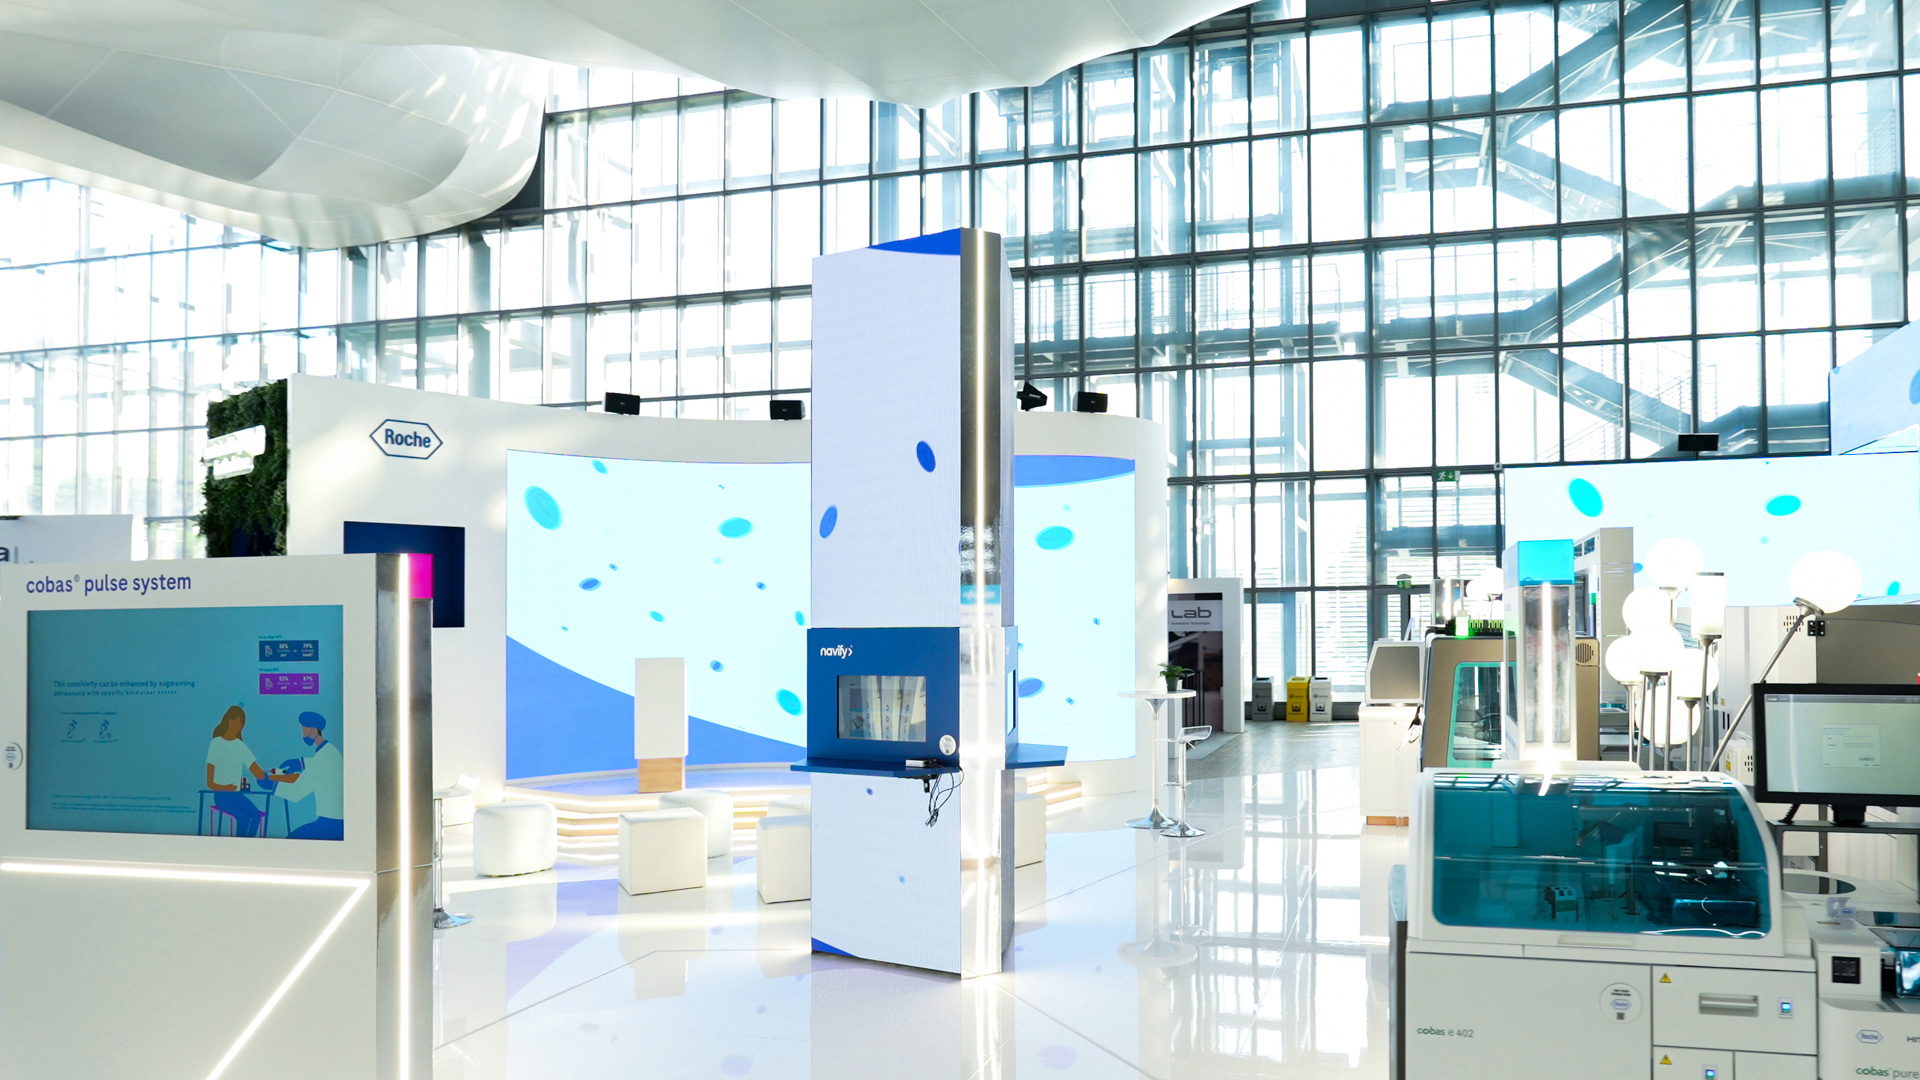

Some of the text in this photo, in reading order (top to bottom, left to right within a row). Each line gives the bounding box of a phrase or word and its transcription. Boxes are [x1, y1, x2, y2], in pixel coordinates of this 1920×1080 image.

[384, 428, 431, 448] Roche
[84, 574, 128, 597] pulse
[132, 574, 192, 596] system
[1171, 606, 1212, 619] Lab
[820, 644, 848, 660] navify
[110, 680, 119, 688] be
[149, 680, 158, 689] by
[158, 680, 196, 689] augmenting
[1417, 1026, 1475, 1038] cobas e 402
